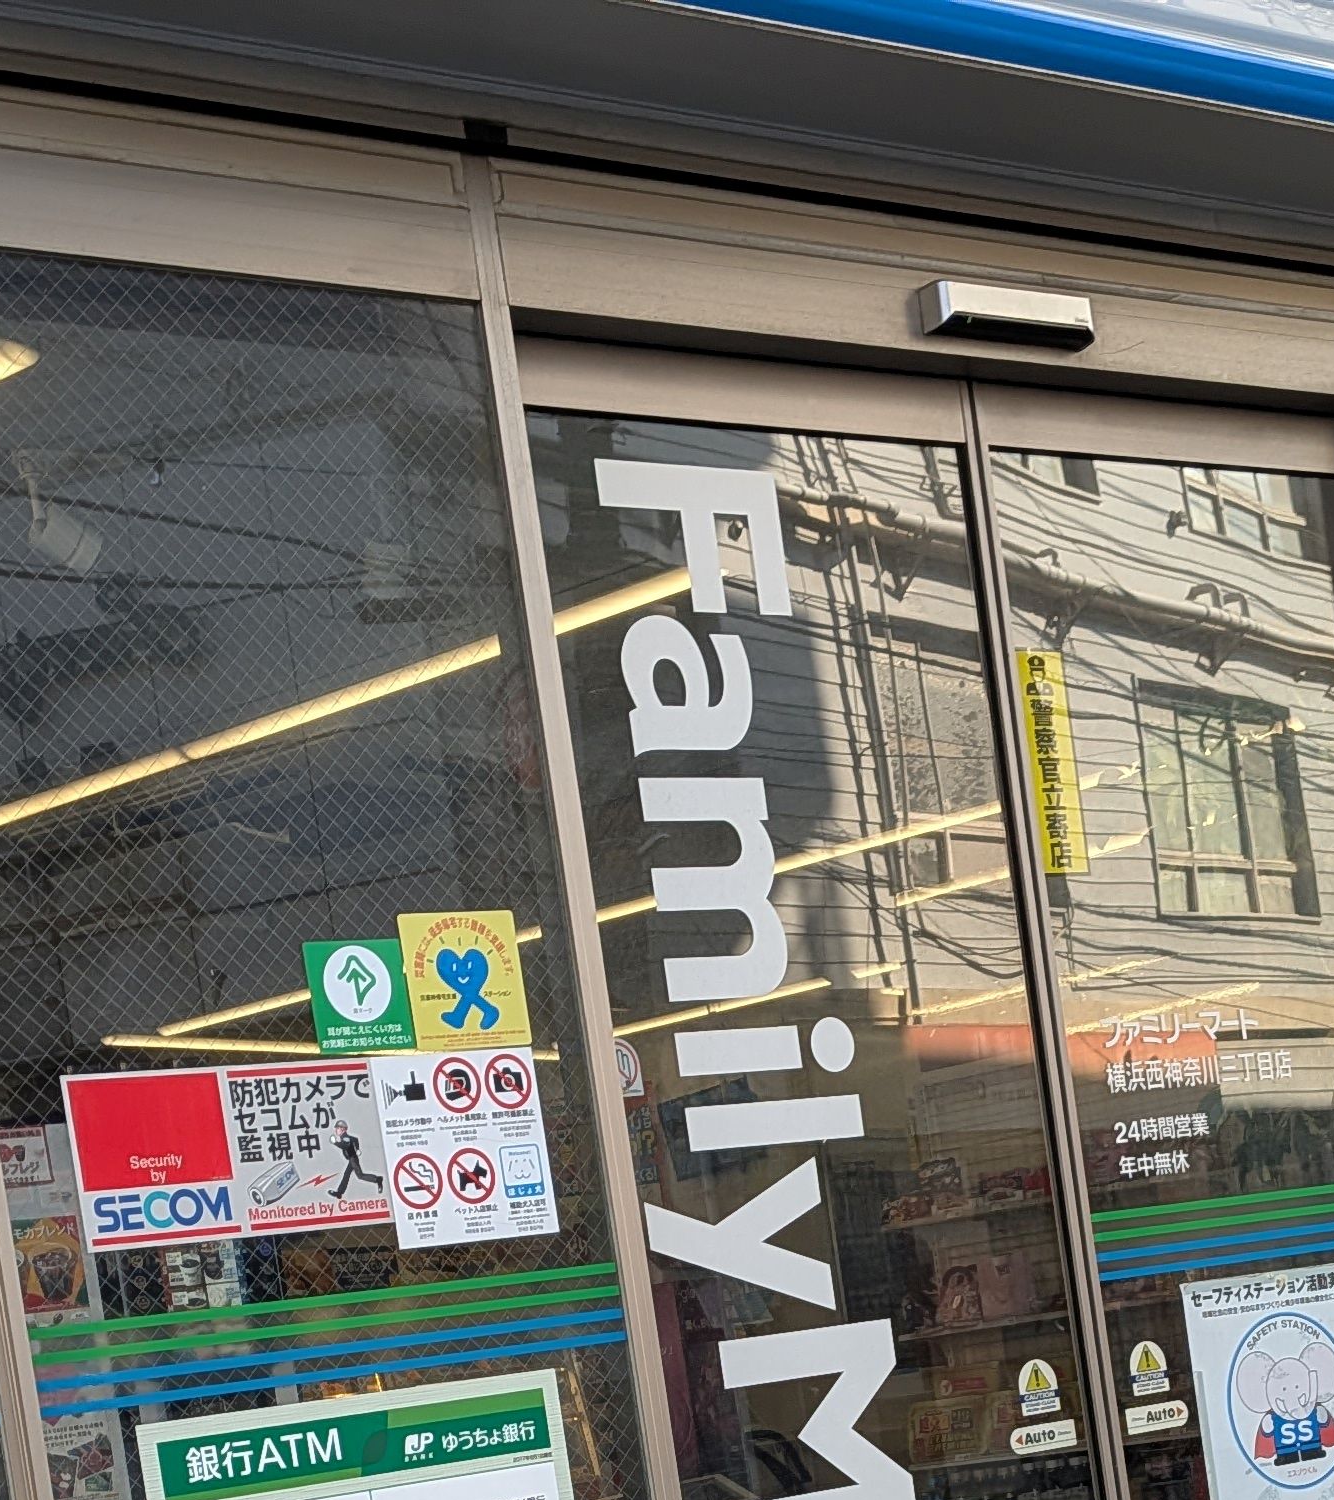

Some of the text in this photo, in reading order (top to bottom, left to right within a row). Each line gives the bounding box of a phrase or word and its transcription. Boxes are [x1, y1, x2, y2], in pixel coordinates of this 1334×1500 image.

[1029, 698, 1073, 869] 警察官立寄店
[1103, 1007, 1260, 1049] ファミリーマート
[1105, 1048, 1294, 1093] 横浜西神奈川三丁目店
[227, 1073, 371, 1110] 防犯カメラで
[233, 1100, 337, 1136] セコムが
[1113, 1112, 1211, 1145] 24時間営業
[129, 1153, 184, 1170] Security
[237, 1132, 321, 1164] 監視中
[1118, 1149, 1191, 1179] 年中無休
[150, 1167, 168, 1184] by
[92, 1186, 234, 1234] SECOM
[247, 1196, 389, 1222] Monitored by Camera
[1246, 1318, 1322, 1351] SAFETY STATION
[1135, 1370, 1166, 1383] CAUTION
[1024, 1390, 1056, 1402] CAUTION
[1146, 1406, 1176, 1424] Auto
[441, 1419, 537, 1452] ゆうちょ銀行
[1024, 1428, 1056, 1447] Auto
[1280, 1419, 1314, 1446] SS
[184, 1426, 344, 1485] 銀行ATM
[404, 1451, 435, 1463] BANK
